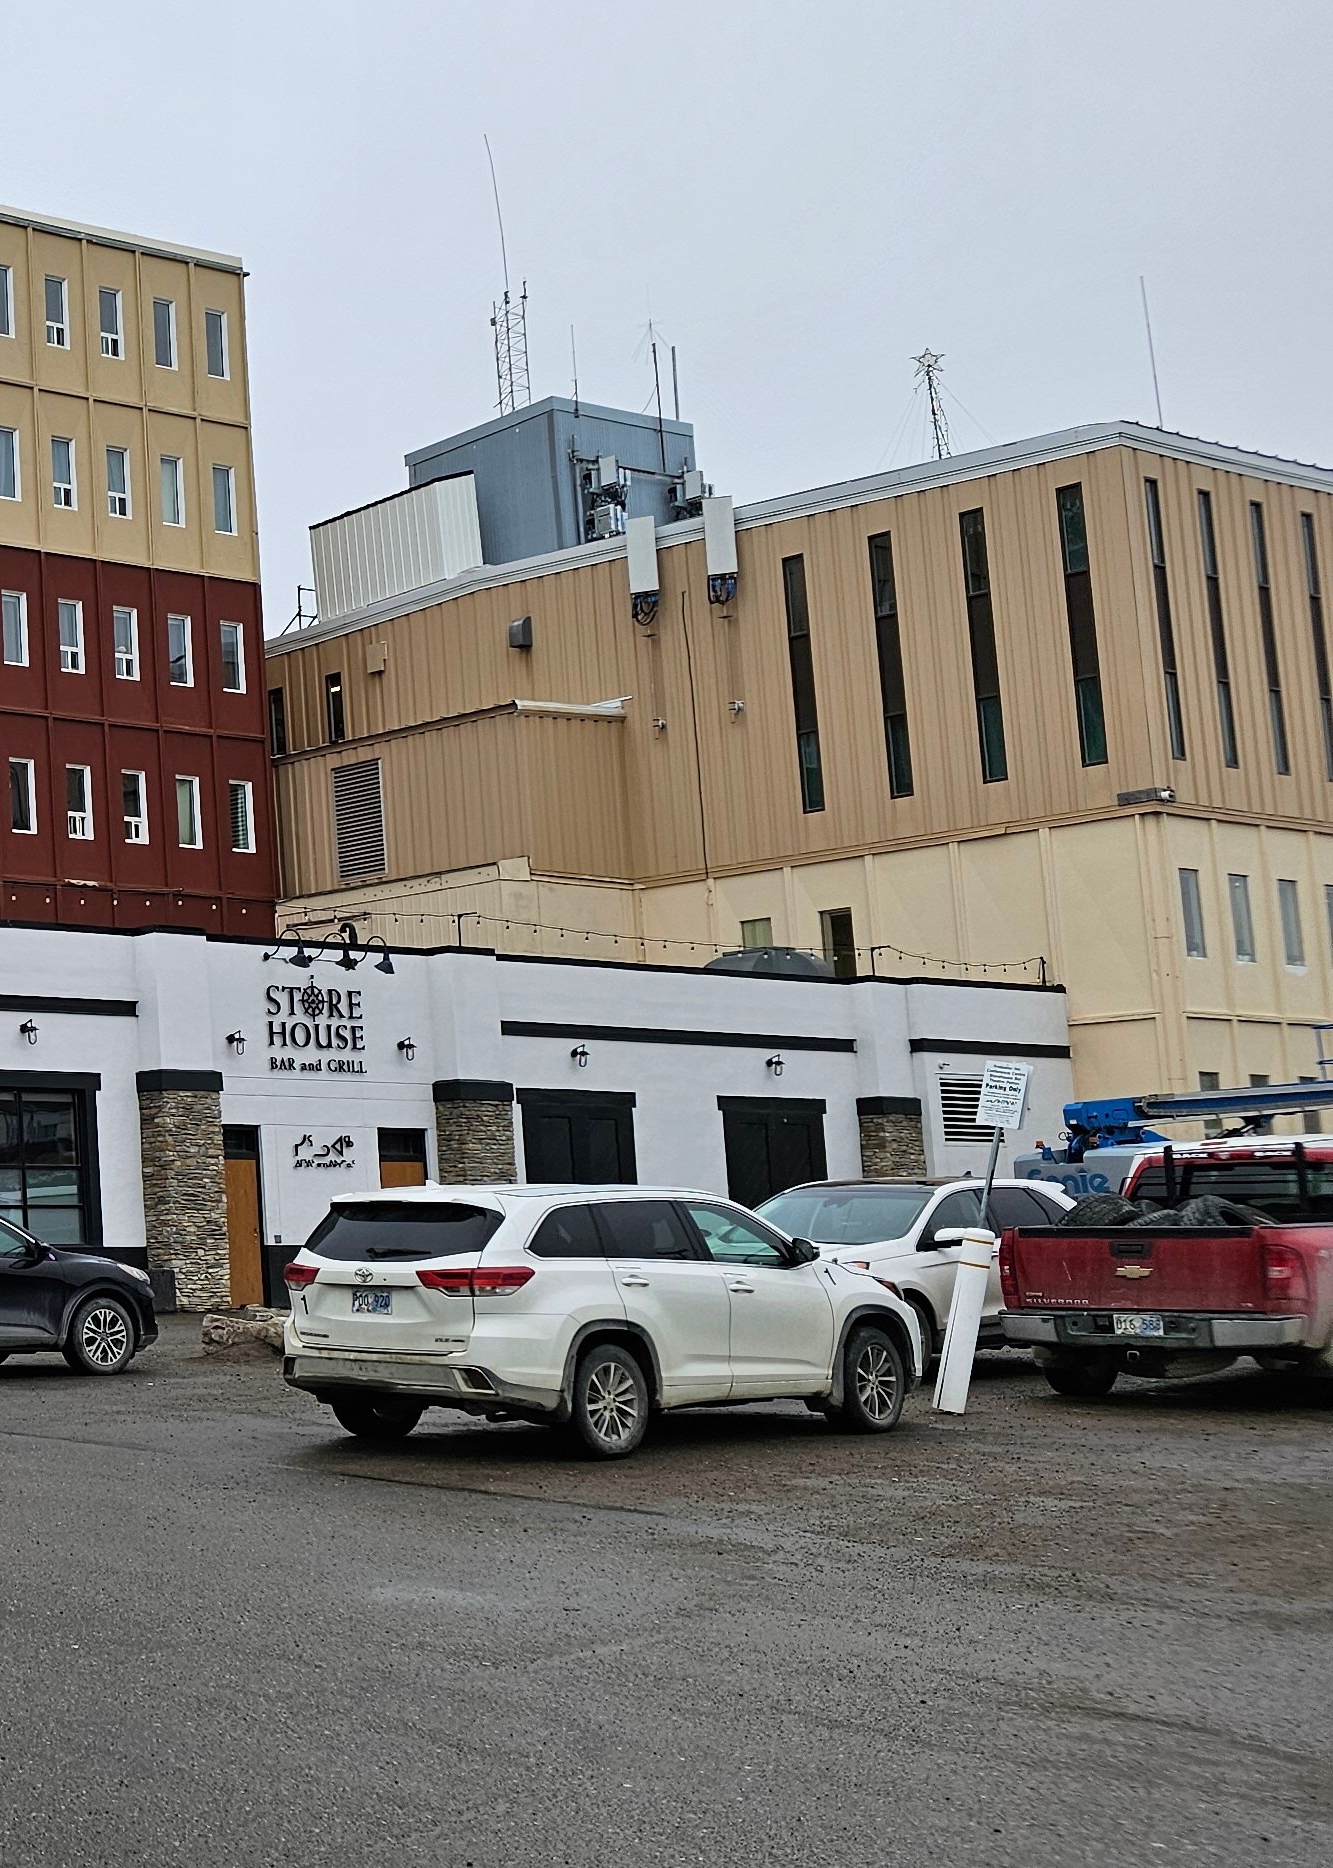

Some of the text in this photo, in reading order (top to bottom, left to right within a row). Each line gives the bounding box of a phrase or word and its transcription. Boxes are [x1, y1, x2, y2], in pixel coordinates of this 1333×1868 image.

[266, 984, 363, 1020] STORE
[268, 1021, 365, 1050] HOUSE
[270, 1057, 367, 1073] BAR and GRILL
[986, 1083, 1006, 1092] Parking
[301, 1295, 308, 1315] 1
[375, 1294, 390, 1307] 920
